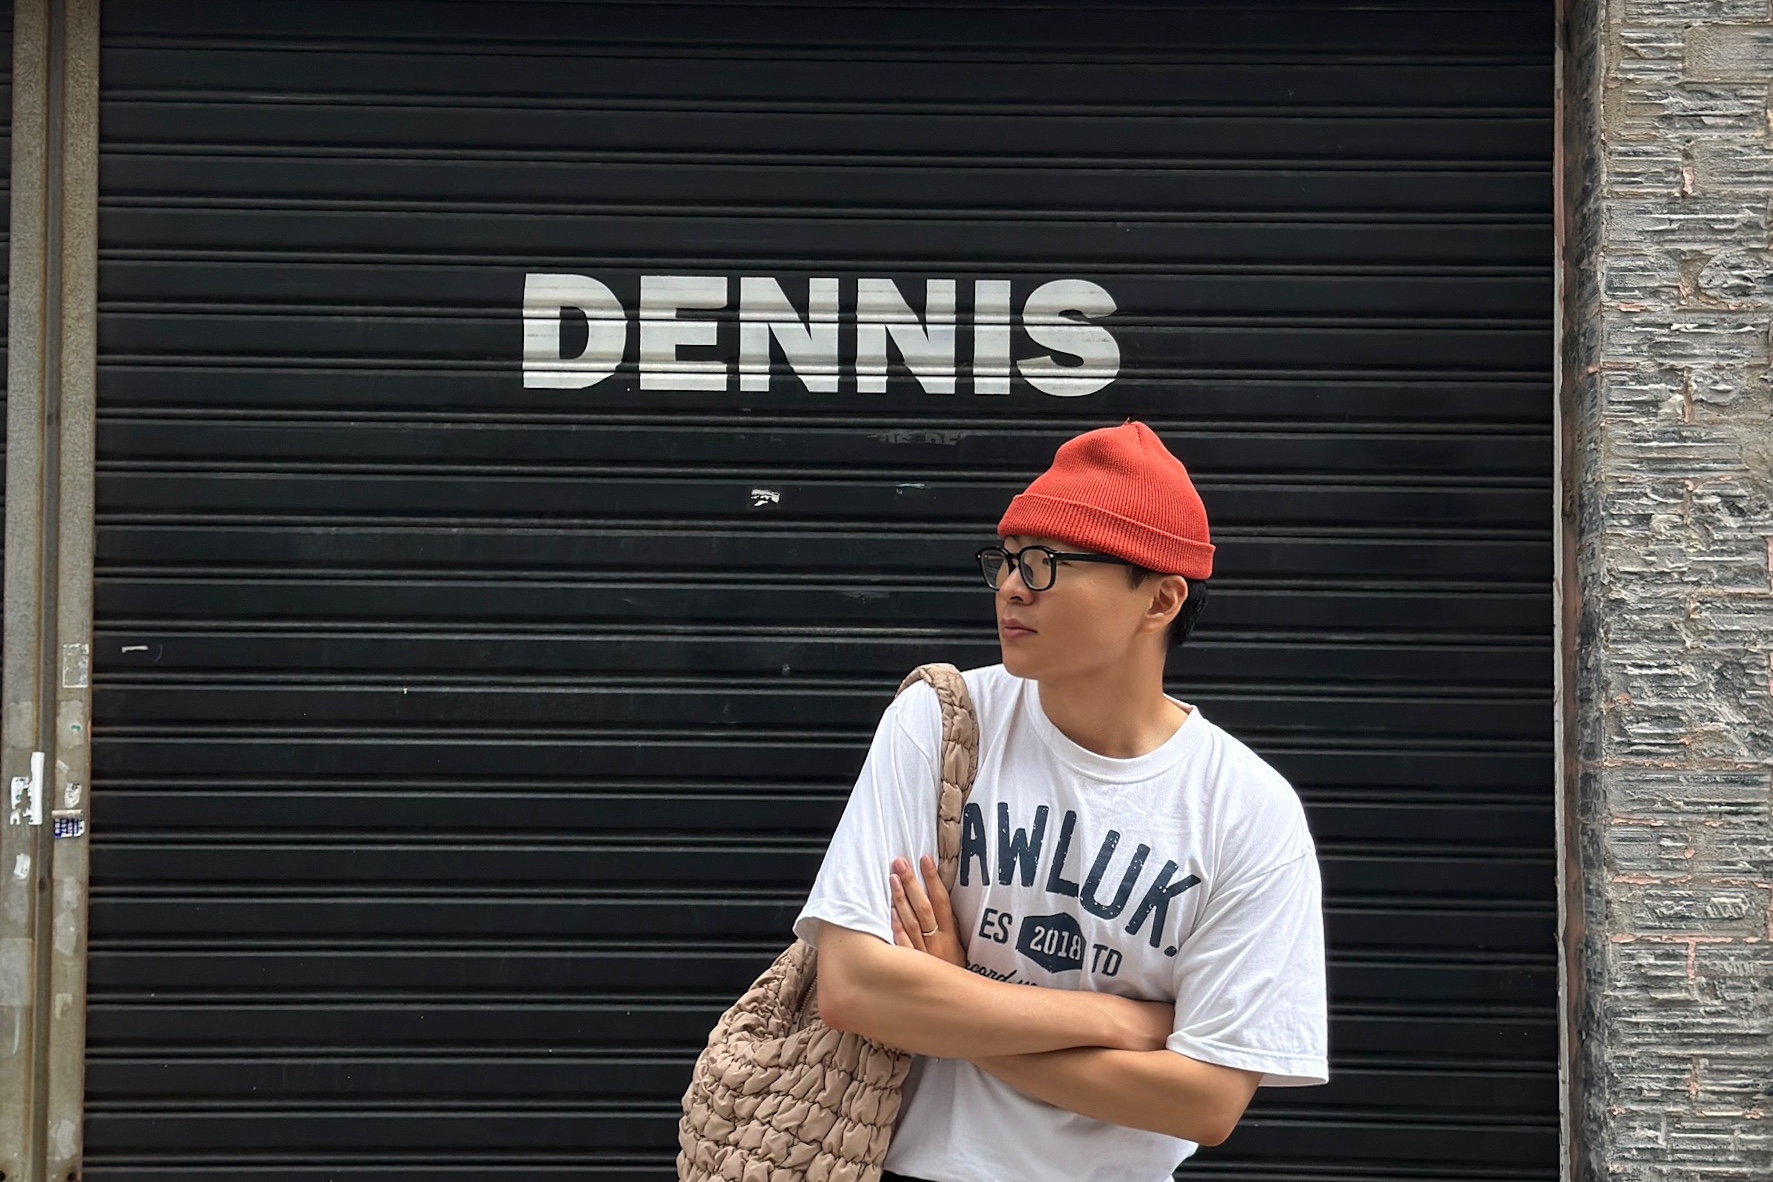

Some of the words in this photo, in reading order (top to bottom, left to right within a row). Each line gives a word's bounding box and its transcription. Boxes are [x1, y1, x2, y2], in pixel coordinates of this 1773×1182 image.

[521, 273, 1121, 397] DENNIS
[978, 908, 1013, 944] ES
[1029, 926, 1083, 961] 2018
[1092, 943, 1124, 977] TD
